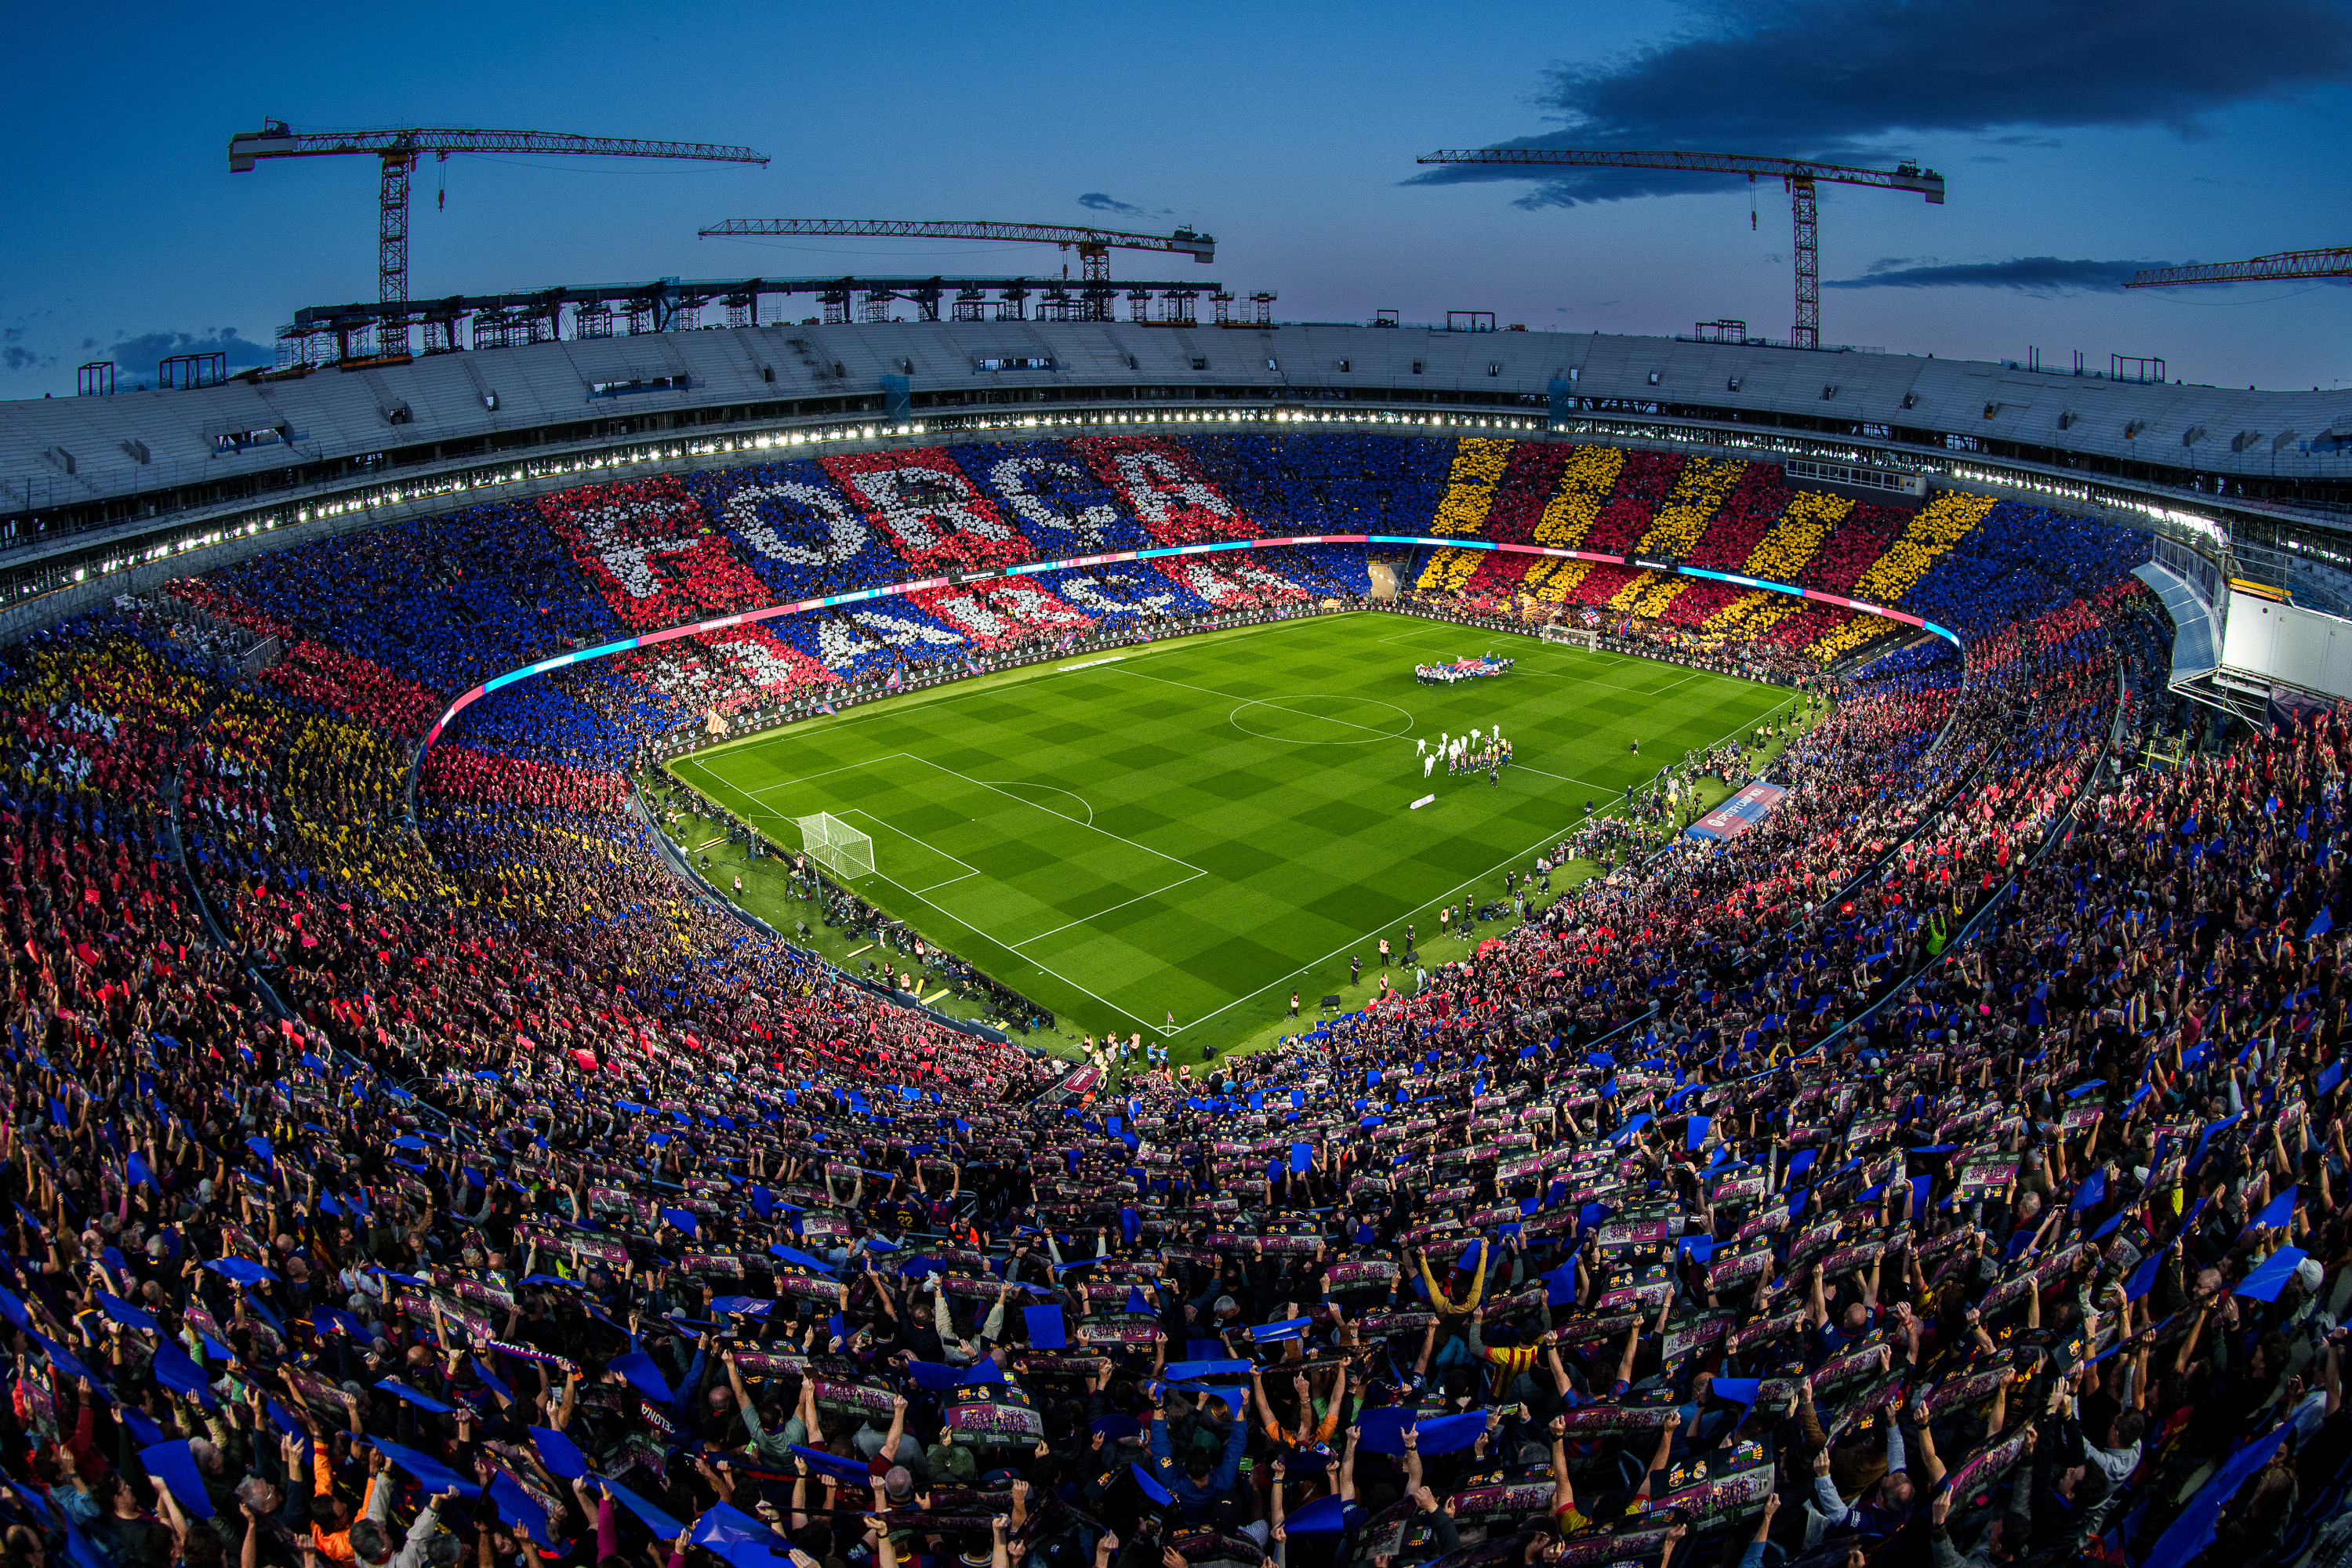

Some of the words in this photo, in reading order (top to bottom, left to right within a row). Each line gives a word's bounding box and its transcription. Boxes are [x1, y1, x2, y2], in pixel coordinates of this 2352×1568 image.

[1716, 802, 1742, 822] SPOTIFY
[1738, 795, 1755, 807] CAMP
[1748, 788, 1764, 798] NOU
